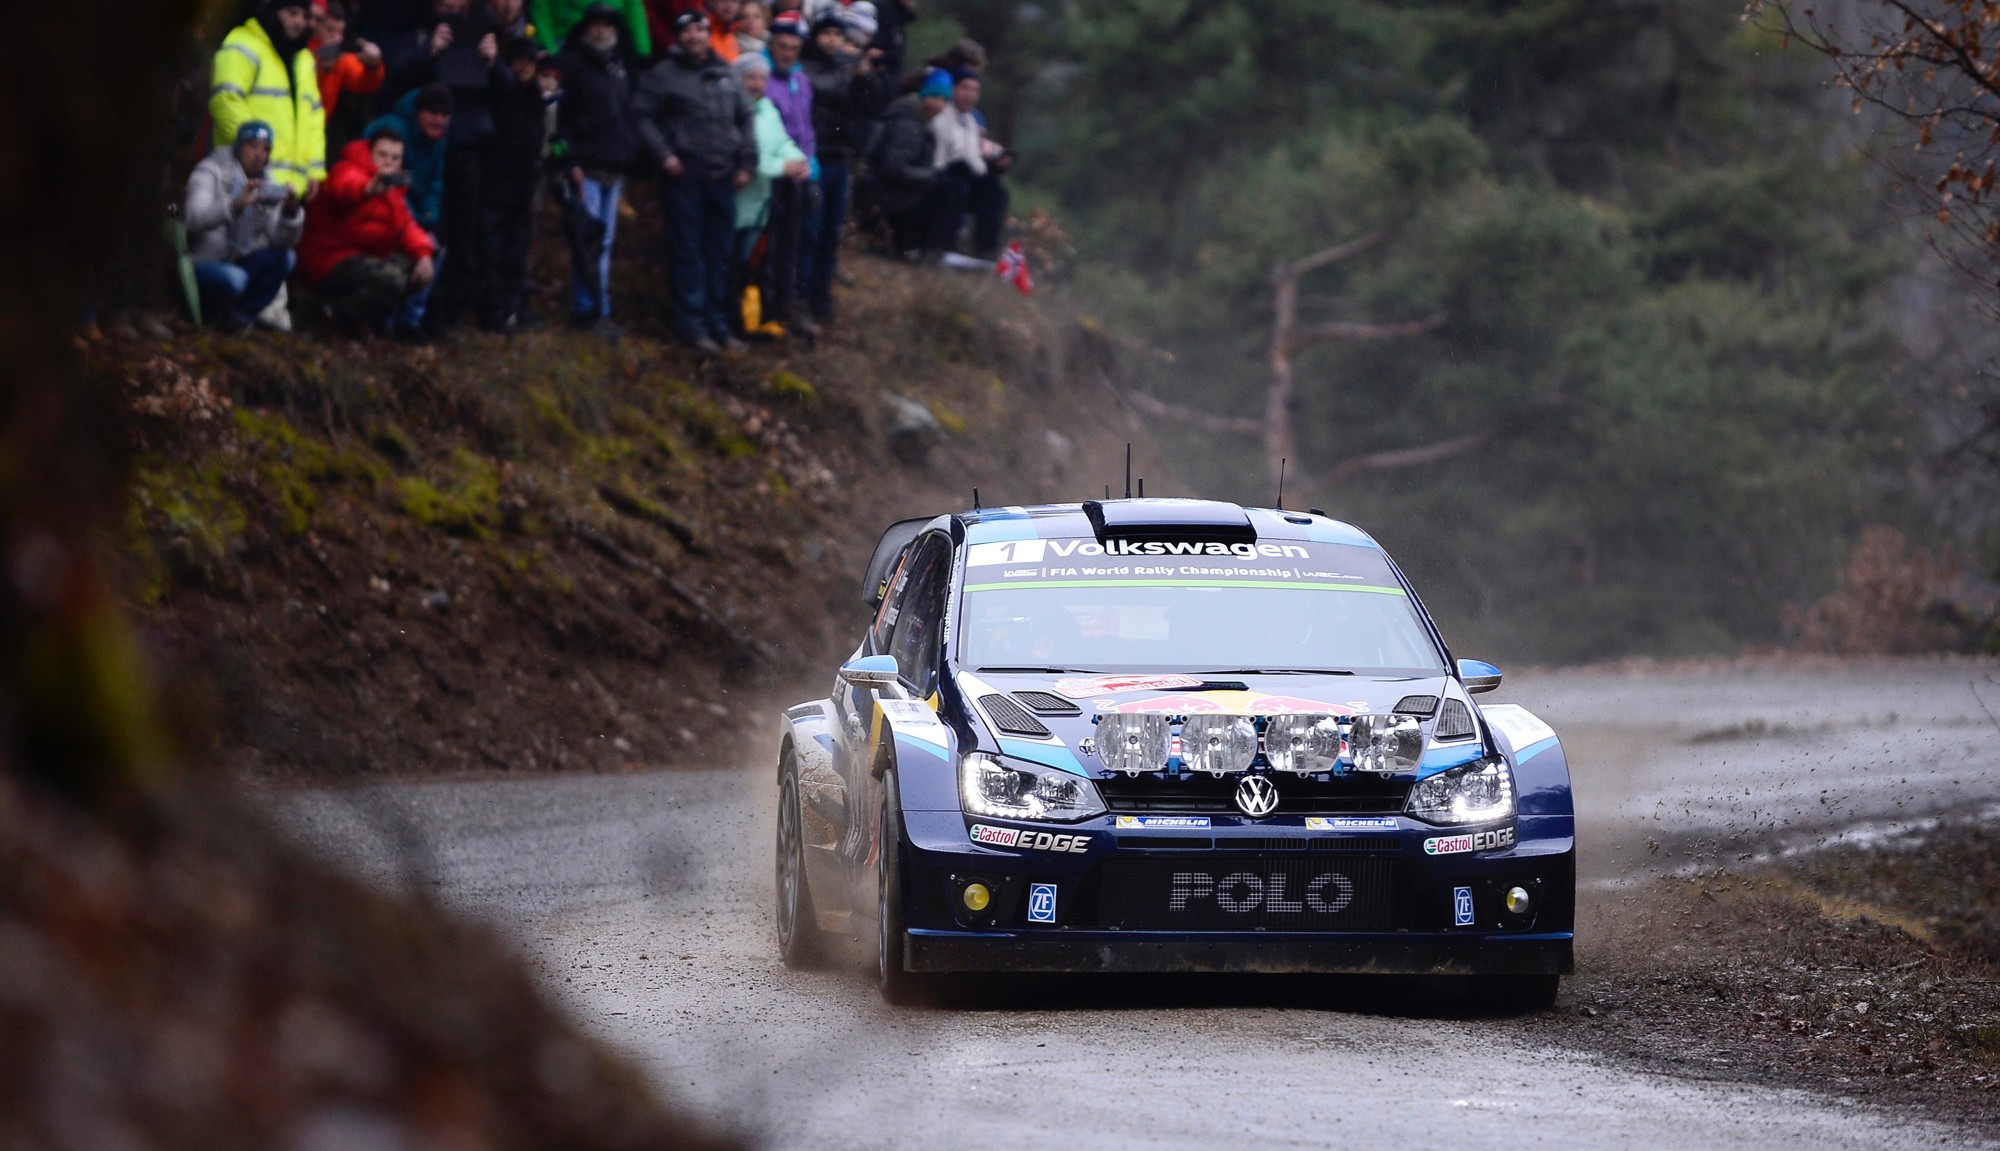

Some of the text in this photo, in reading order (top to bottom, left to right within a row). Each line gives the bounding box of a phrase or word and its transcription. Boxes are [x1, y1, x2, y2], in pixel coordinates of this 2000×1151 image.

[1048, 539, 1310, 560] Volkswagen
[1050, 566, 1291, 578] FIA World Rally Championship
[979, 827, 1093, 853] Castrol EDGE
[1437, 826, 1515, 853] Castrol EDGE
[1169, 872, 1353, 913] POLO
